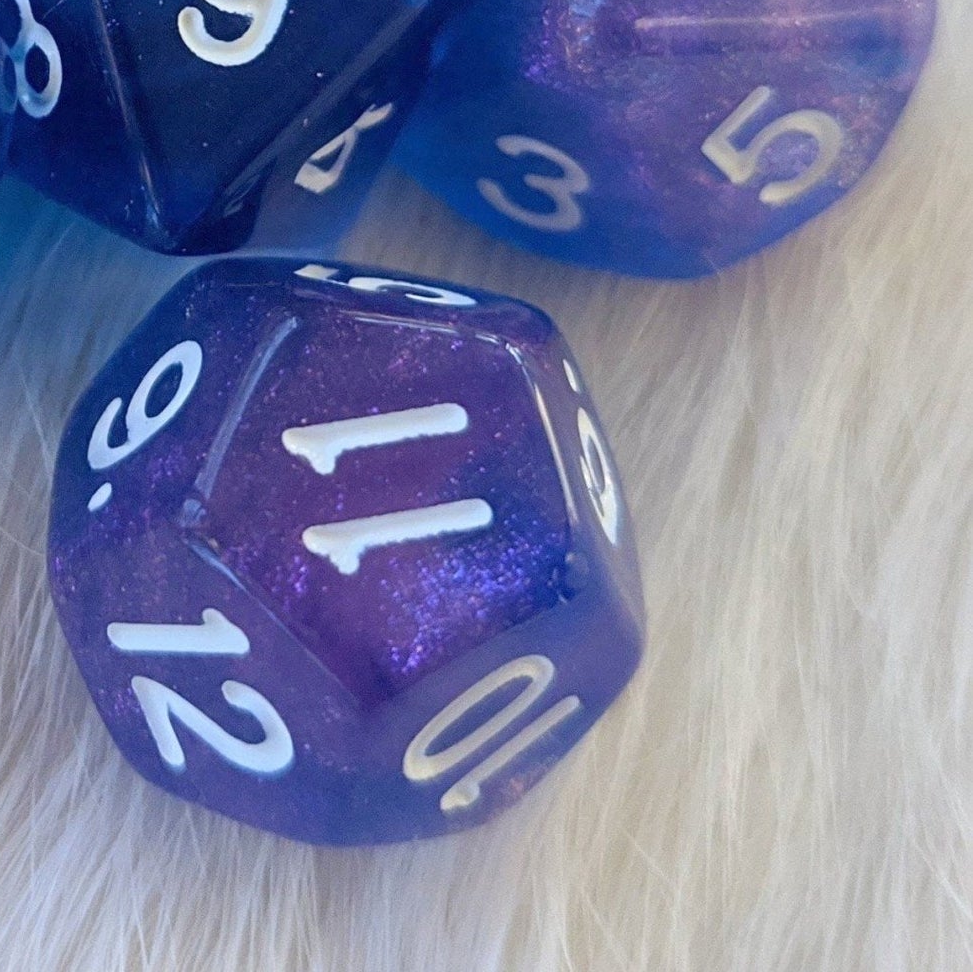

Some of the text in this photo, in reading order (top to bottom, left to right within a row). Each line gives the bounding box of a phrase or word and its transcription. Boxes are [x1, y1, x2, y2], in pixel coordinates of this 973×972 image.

[294, 101, 394, 194] 4
[477, 134, 590, 232] 3
[702, 84, 845, 206] 5
[281, 402, 493, 575] 11
[107, 607, 294, 774] 12
[404, 654, 585, 815] 10
